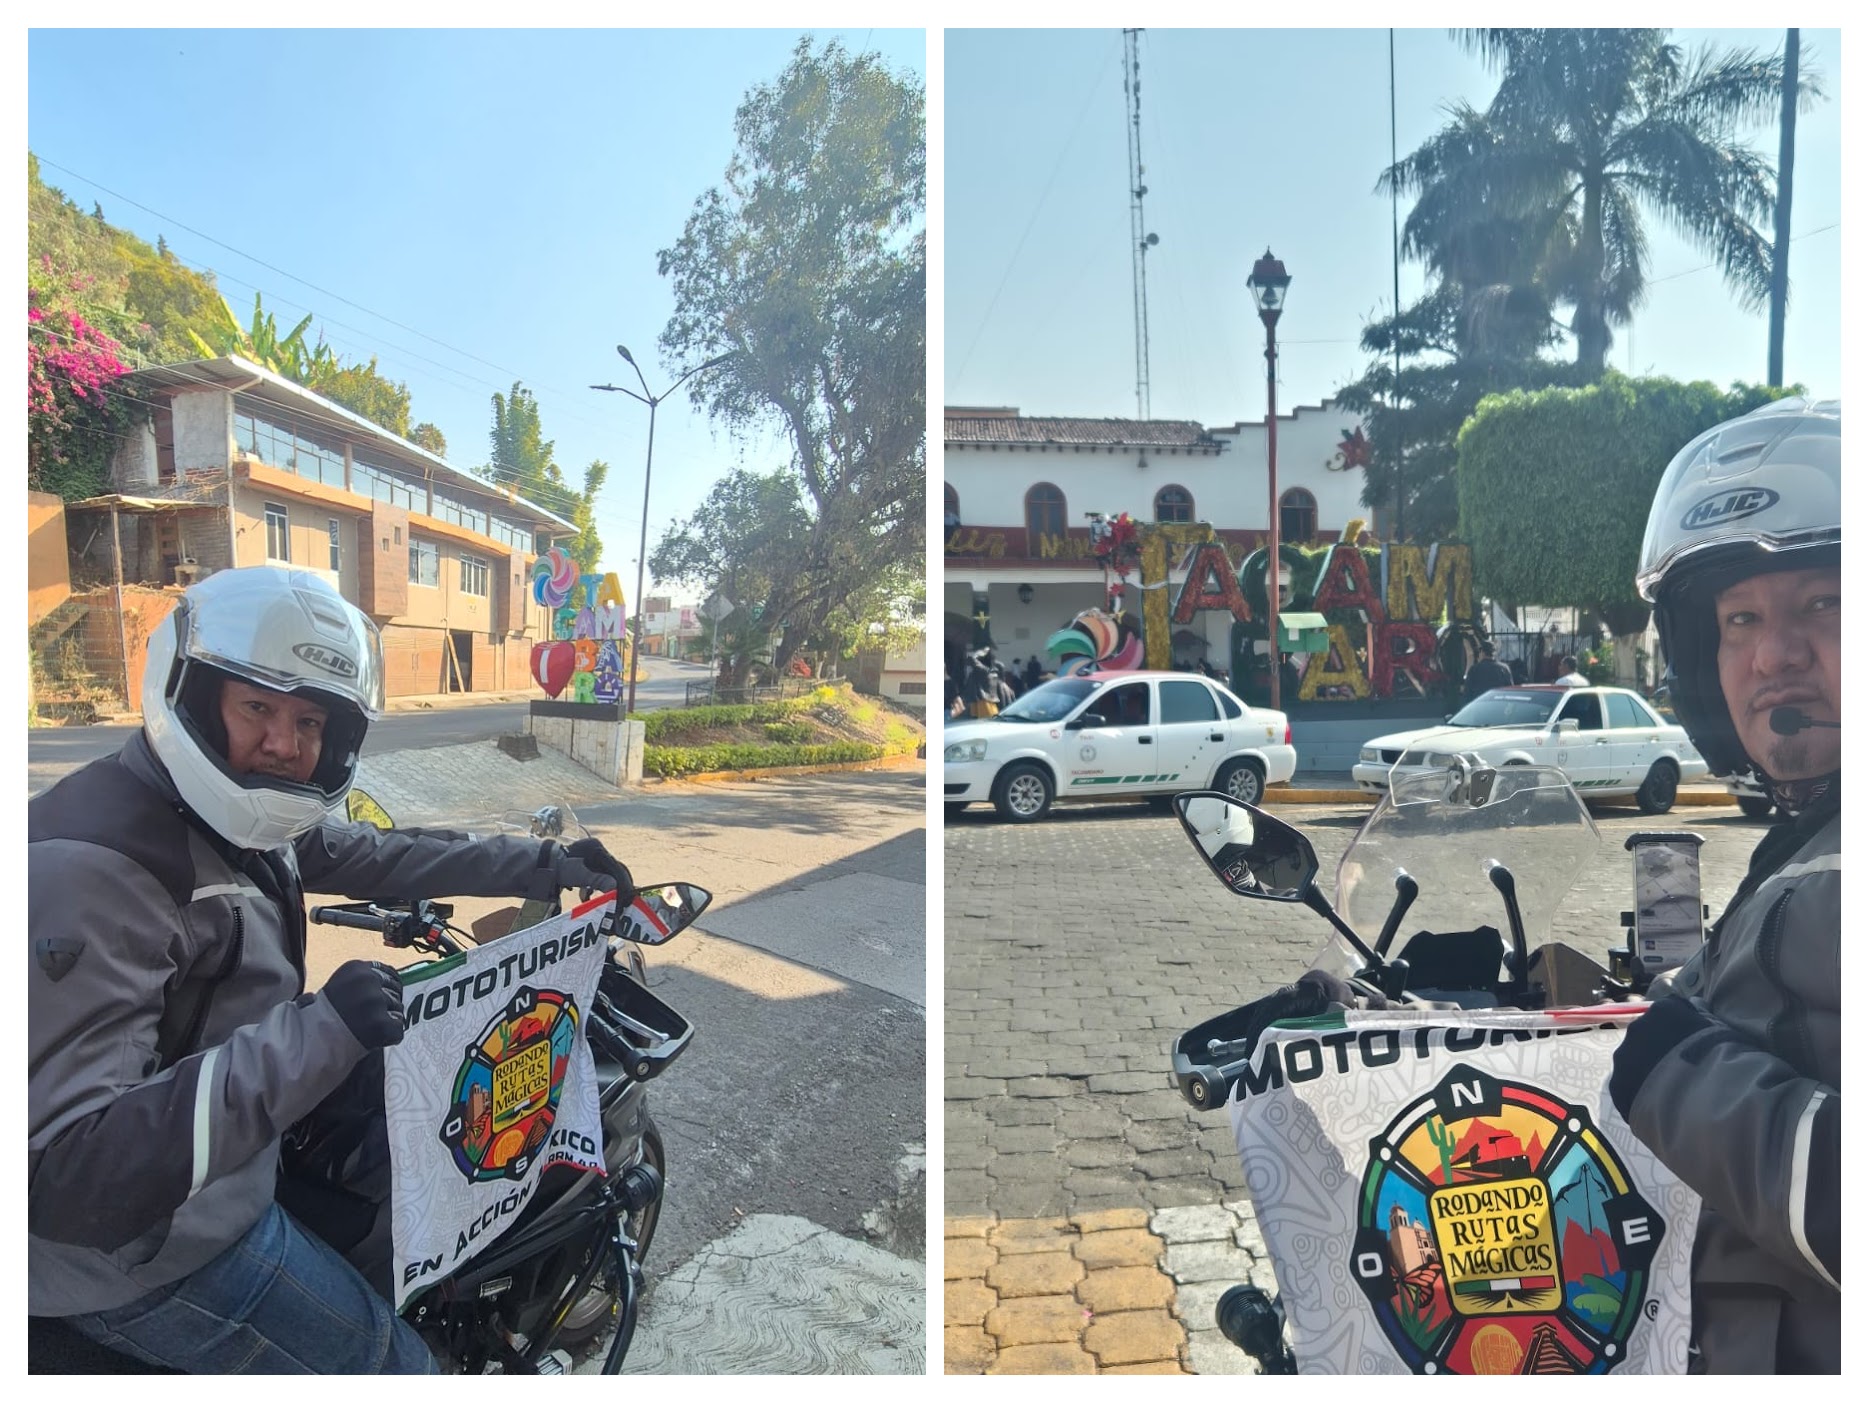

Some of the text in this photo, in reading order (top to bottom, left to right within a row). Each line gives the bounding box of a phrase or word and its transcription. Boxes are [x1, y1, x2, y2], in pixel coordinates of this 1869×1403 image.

[1690, 490, 1765, 525] HJC
[303, 646, 354, 675] HJC
[515, 992, 531, 1011] N
[1450, 1080, 1484, 1107] N
[1434, 1185, 1544, 1219] RODANDO
[403, 1180, 532, 1289] EN ACCIÓN
[1450, 1213, 1540, 1247] RUTAS
[1622, 1217, 1651, 1245] E
[1357, 1253, 1384, 1278] O
